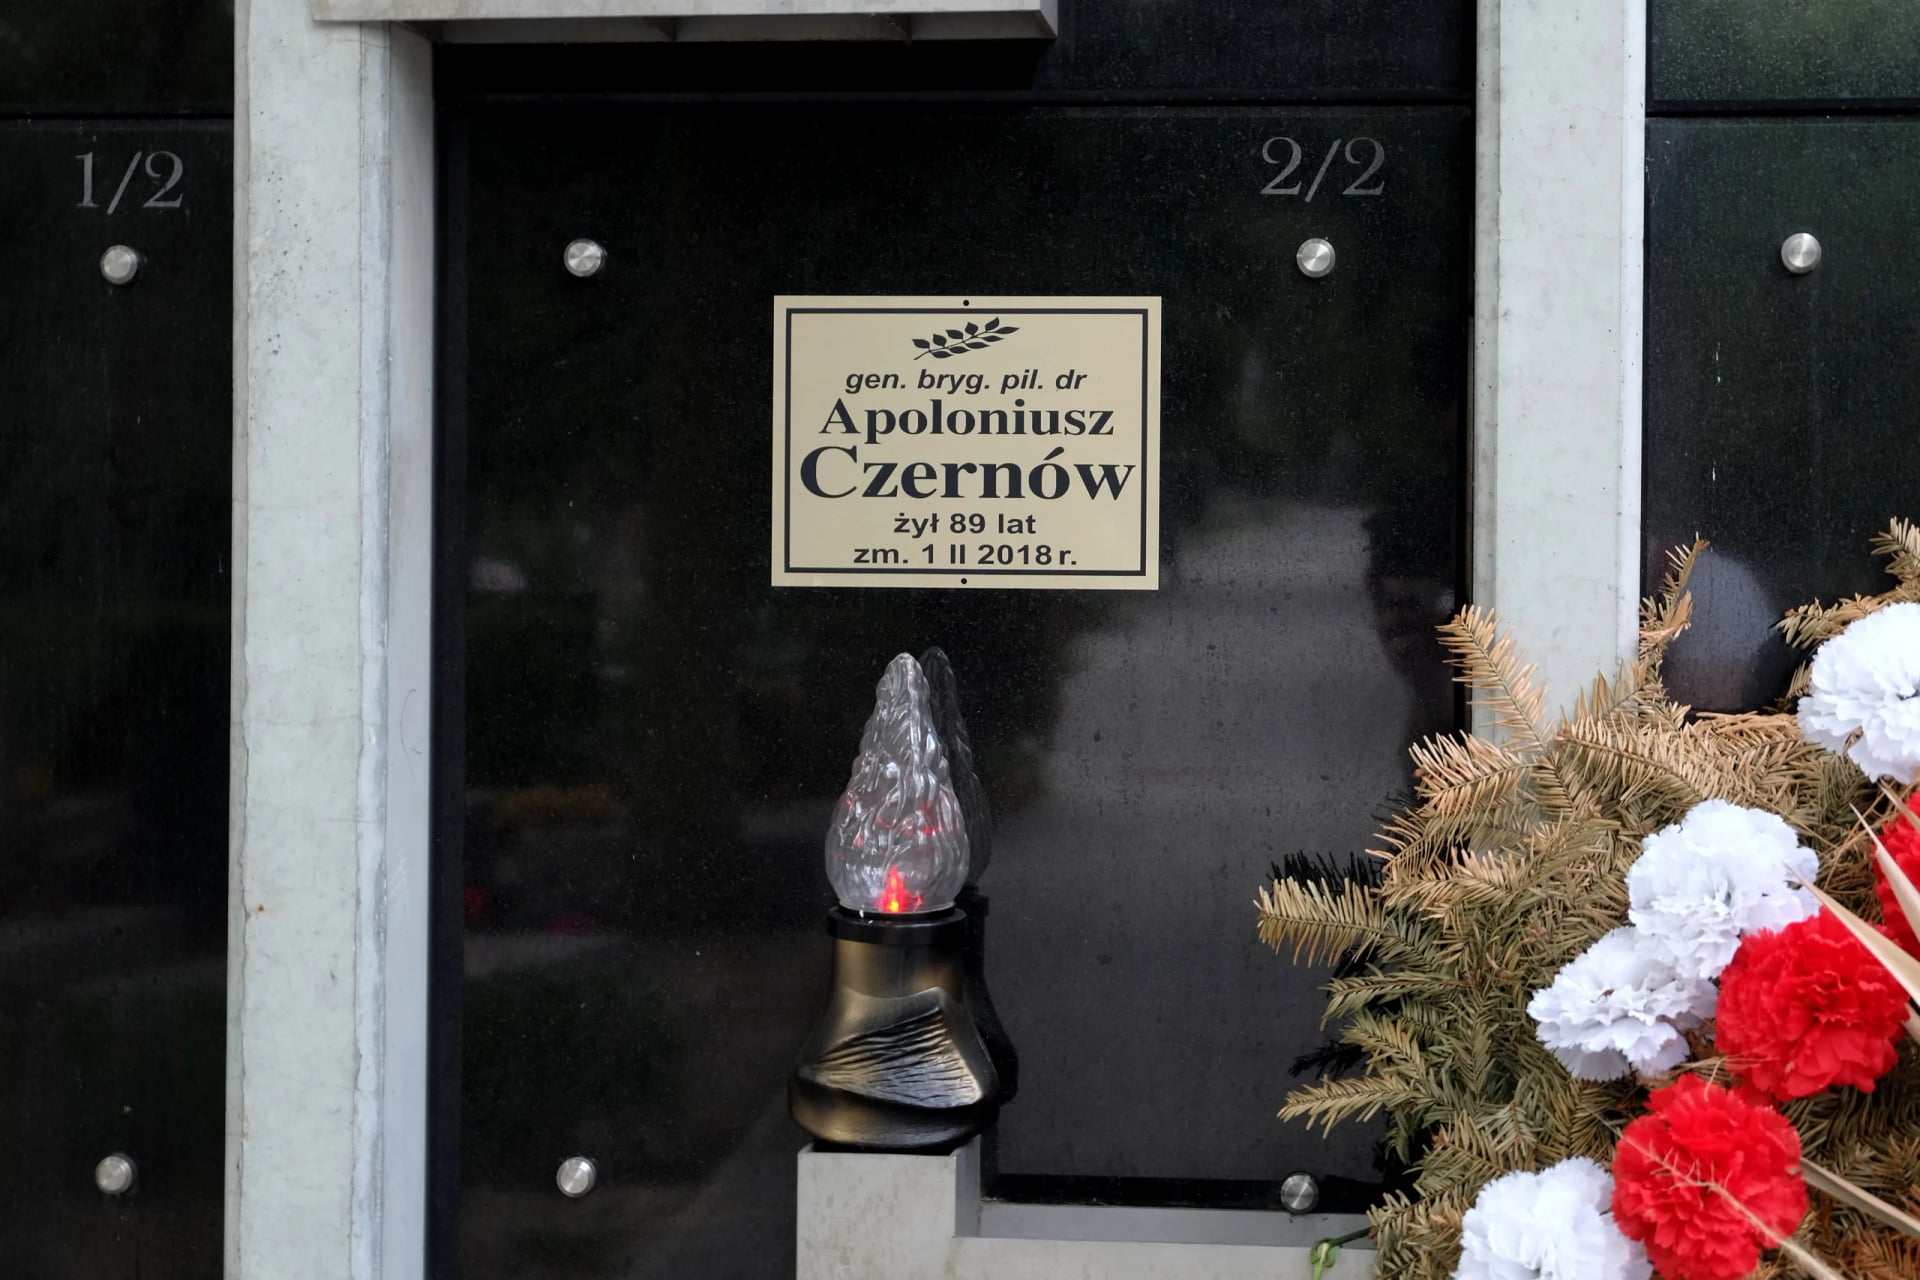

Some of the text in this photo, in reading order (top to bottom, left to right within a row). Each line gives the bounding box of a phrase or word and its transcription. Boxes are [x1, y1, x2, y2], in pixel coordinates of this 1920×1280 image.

[74, 150, 184, 216] 1/2
[1259, 136, 1386, 203] 2/2
[844, 368, 1088, 395] gen. bryg. pil. dr
[818, 397, 1115, 445] Apoloniusz
[799, 444, 1137, 501] Czernów
[893, 512, 1037, 539] żył 89 lat
[853, 548, 909, 565] zm.
[921, 543, 935, 565] 1
[950, 543, 967, 566] II
